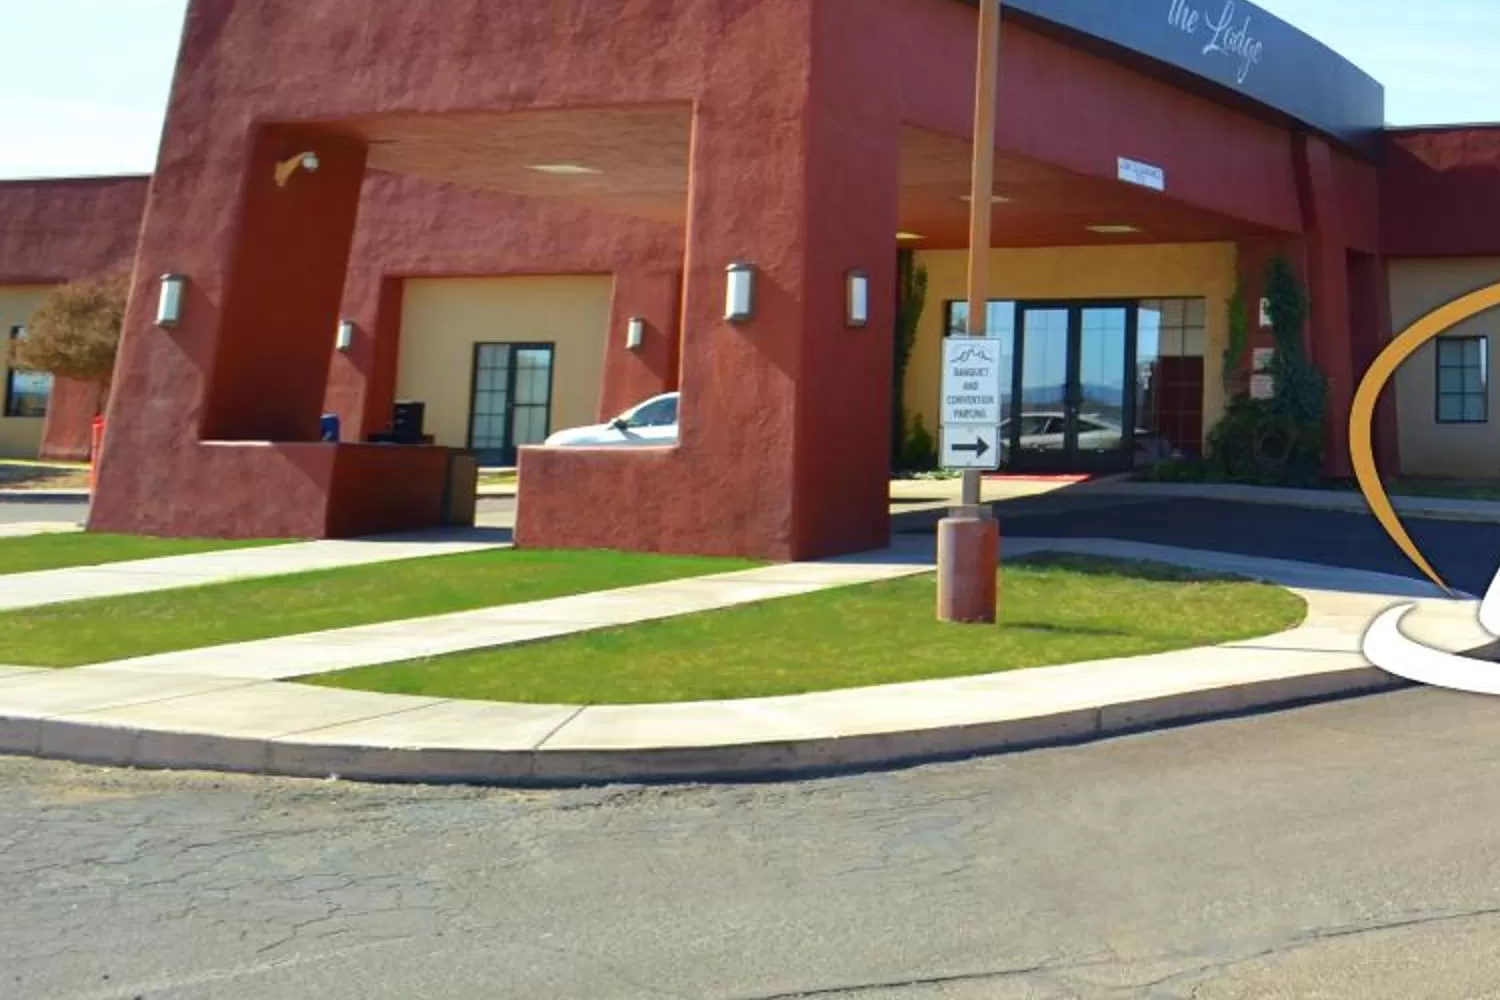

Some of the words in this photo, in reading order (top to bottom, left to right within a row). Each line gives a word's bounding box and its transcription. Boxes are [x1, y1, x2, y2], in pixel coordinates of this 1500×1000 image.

[1202, 0, 1264, 85] Lodge
[953, 367, 989, 377] BANQUET
[962, 380, 979, 391] AND
[946, 395, 995, 405] CONVENTION
[953, 408, 988, 419] PARKING
